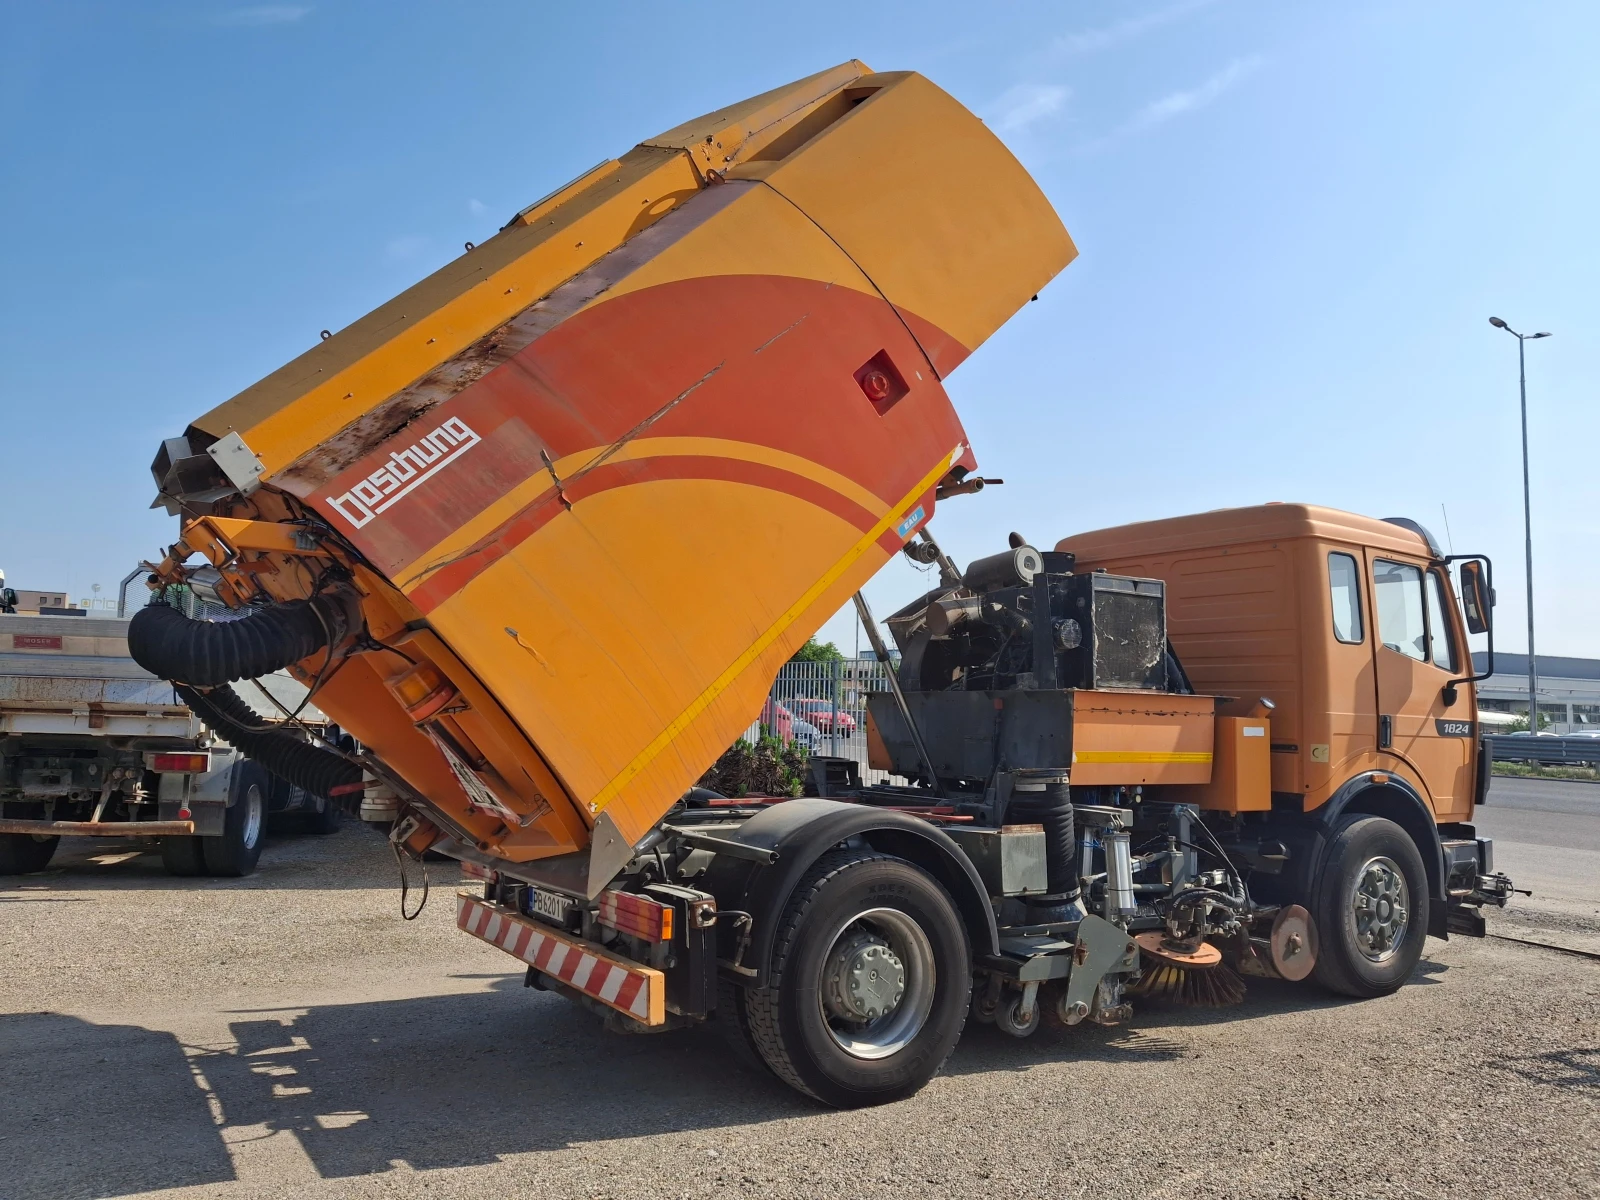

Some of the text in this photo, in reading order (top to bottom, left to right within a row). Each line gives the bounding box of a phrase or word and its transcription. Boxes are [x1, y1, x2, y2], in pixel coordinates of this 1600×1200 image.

[325, 416, 482, 529] boschung
[904, 513, 918, 530] EAU
[1443, 723, 1469, 734] 1824
